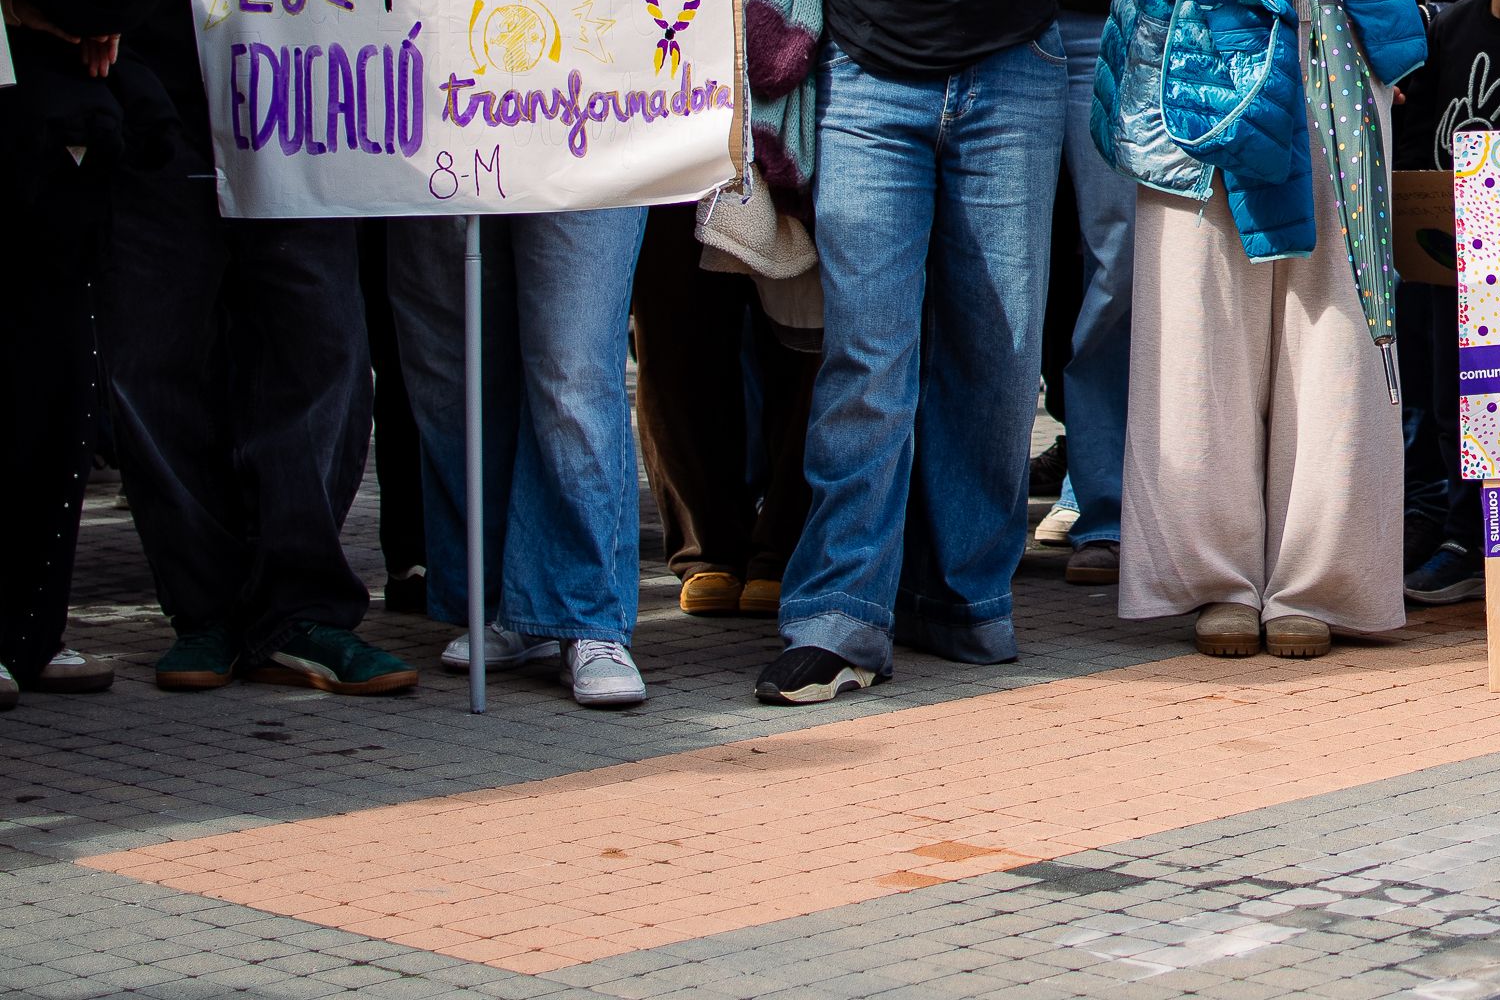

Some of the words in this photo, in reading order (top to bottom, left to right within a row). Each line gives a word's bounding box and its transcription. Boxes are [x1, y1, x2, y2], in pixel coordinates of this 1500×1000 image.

[229, 20, 425, 158] EDUCACIÓ
[428, 144, 506, 200] 8-M
[1488, 489, 1500, 543] comuns
